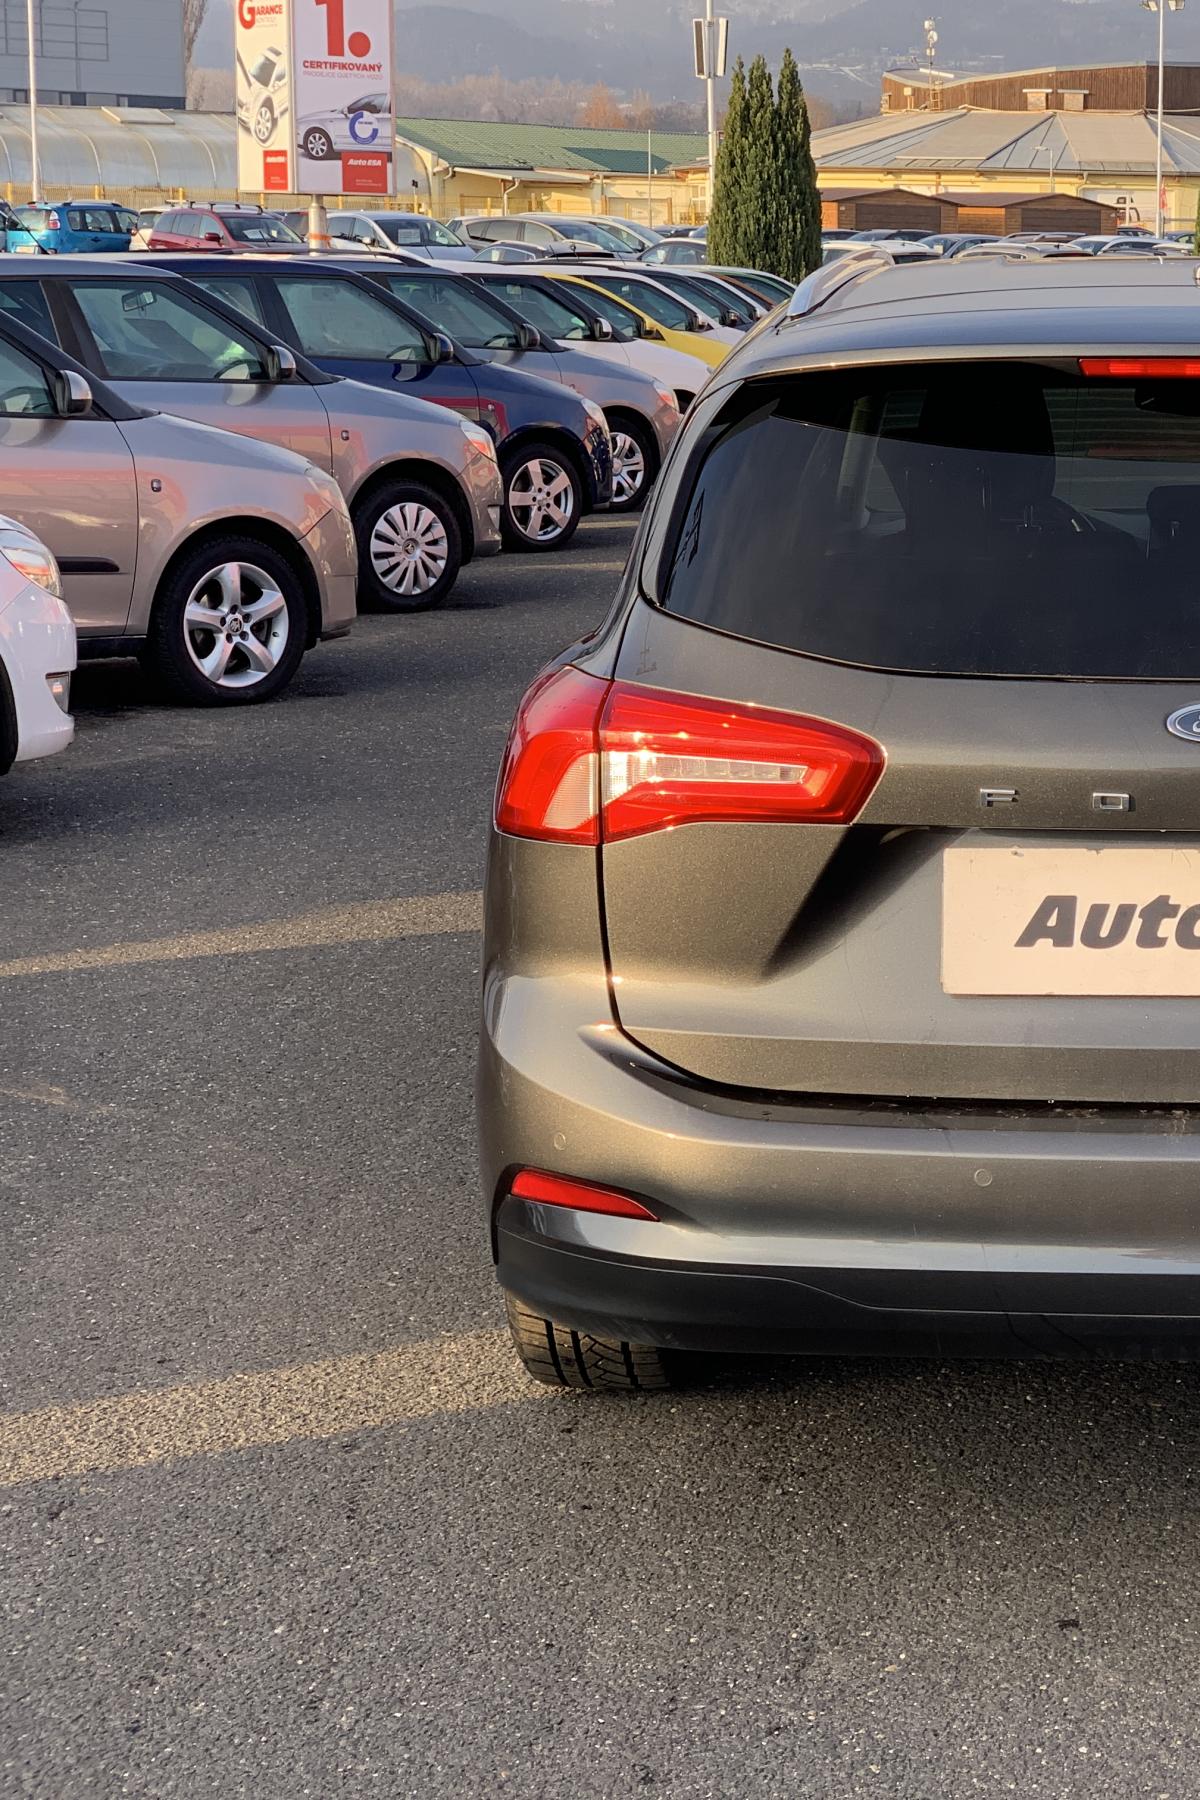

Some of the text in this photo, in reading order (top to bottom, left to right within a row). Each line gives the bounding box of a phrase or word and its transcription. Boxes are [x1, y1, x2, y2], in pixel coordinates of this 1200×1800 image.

[315, 0, 371, 57] 1.
[303, 60, 383, 72] CERTIFIKOVANÝ
[347, 158, 382, 167] Auto ESA
